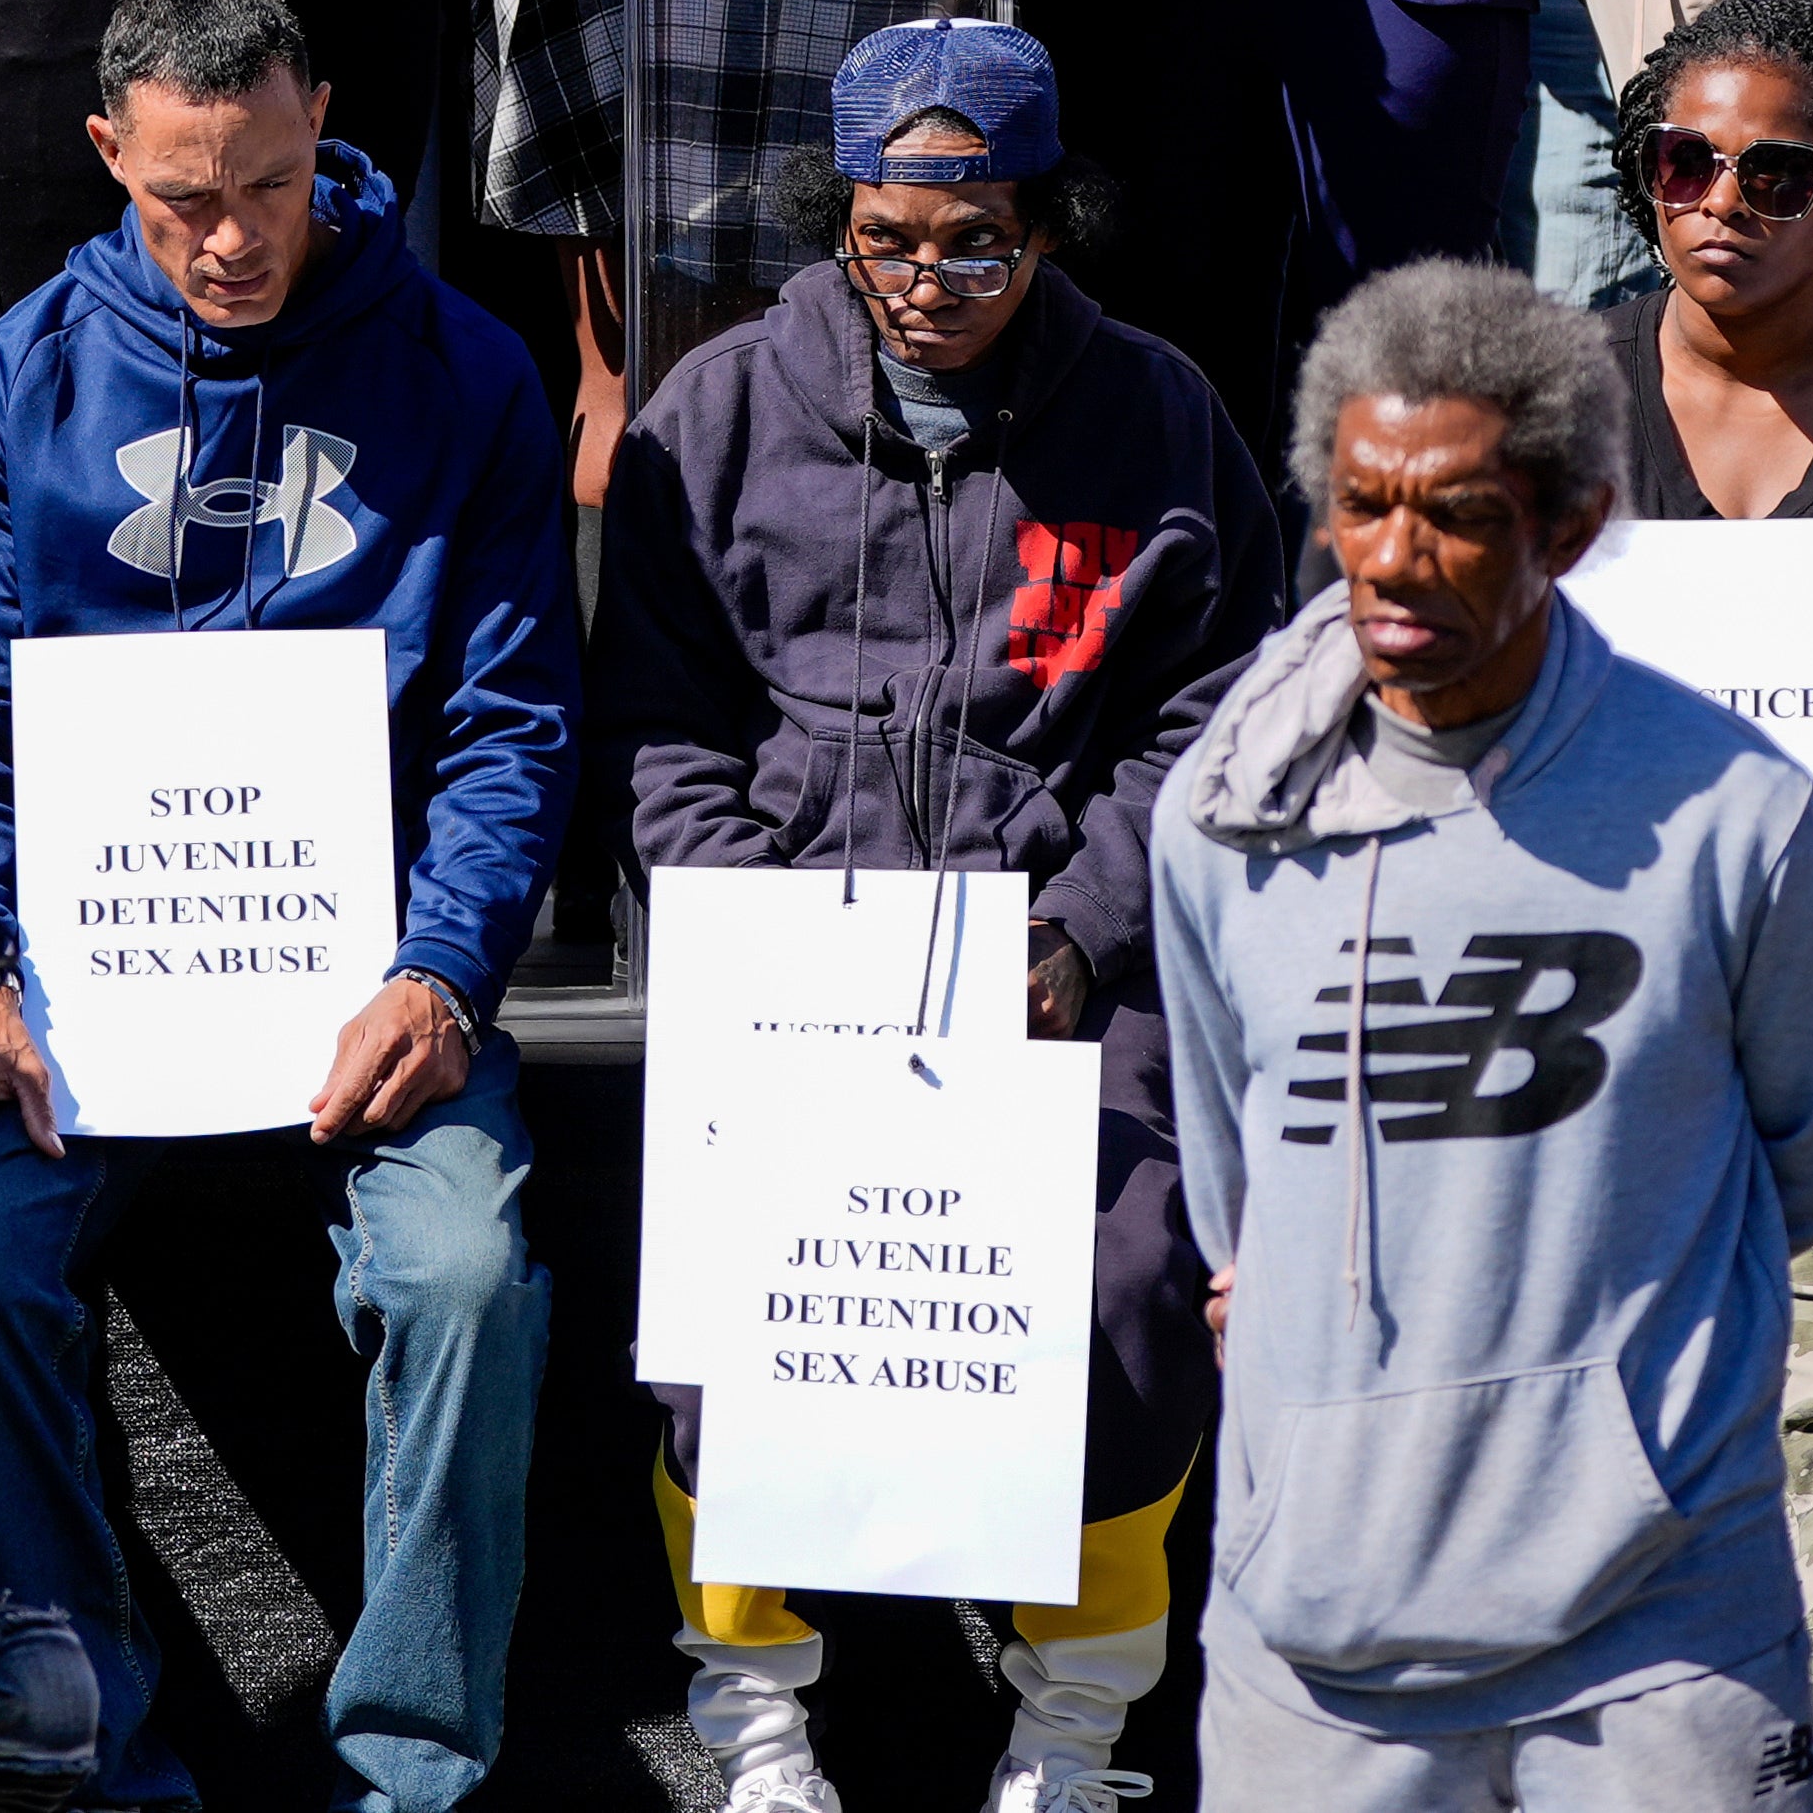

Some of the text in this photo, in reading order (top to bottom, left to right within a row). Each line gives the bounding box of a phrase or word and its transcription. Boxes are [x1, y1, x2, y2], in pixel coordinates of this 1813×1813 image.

[151, 787, 261, 816] STOP
[96, 840, 315, 872] JUVENILE
[80, 893, 337, 925] DETENTION
[91, 946, 329, 975] SEX ABUSE
[848, 1187, 961, 1216] STOP
[788, 1239, 1011, 1276] JUVENILE
[765, 1293, 1030, 1336] DETENTION
[774, 1351, 1016, 1394] SEX ABUSE
